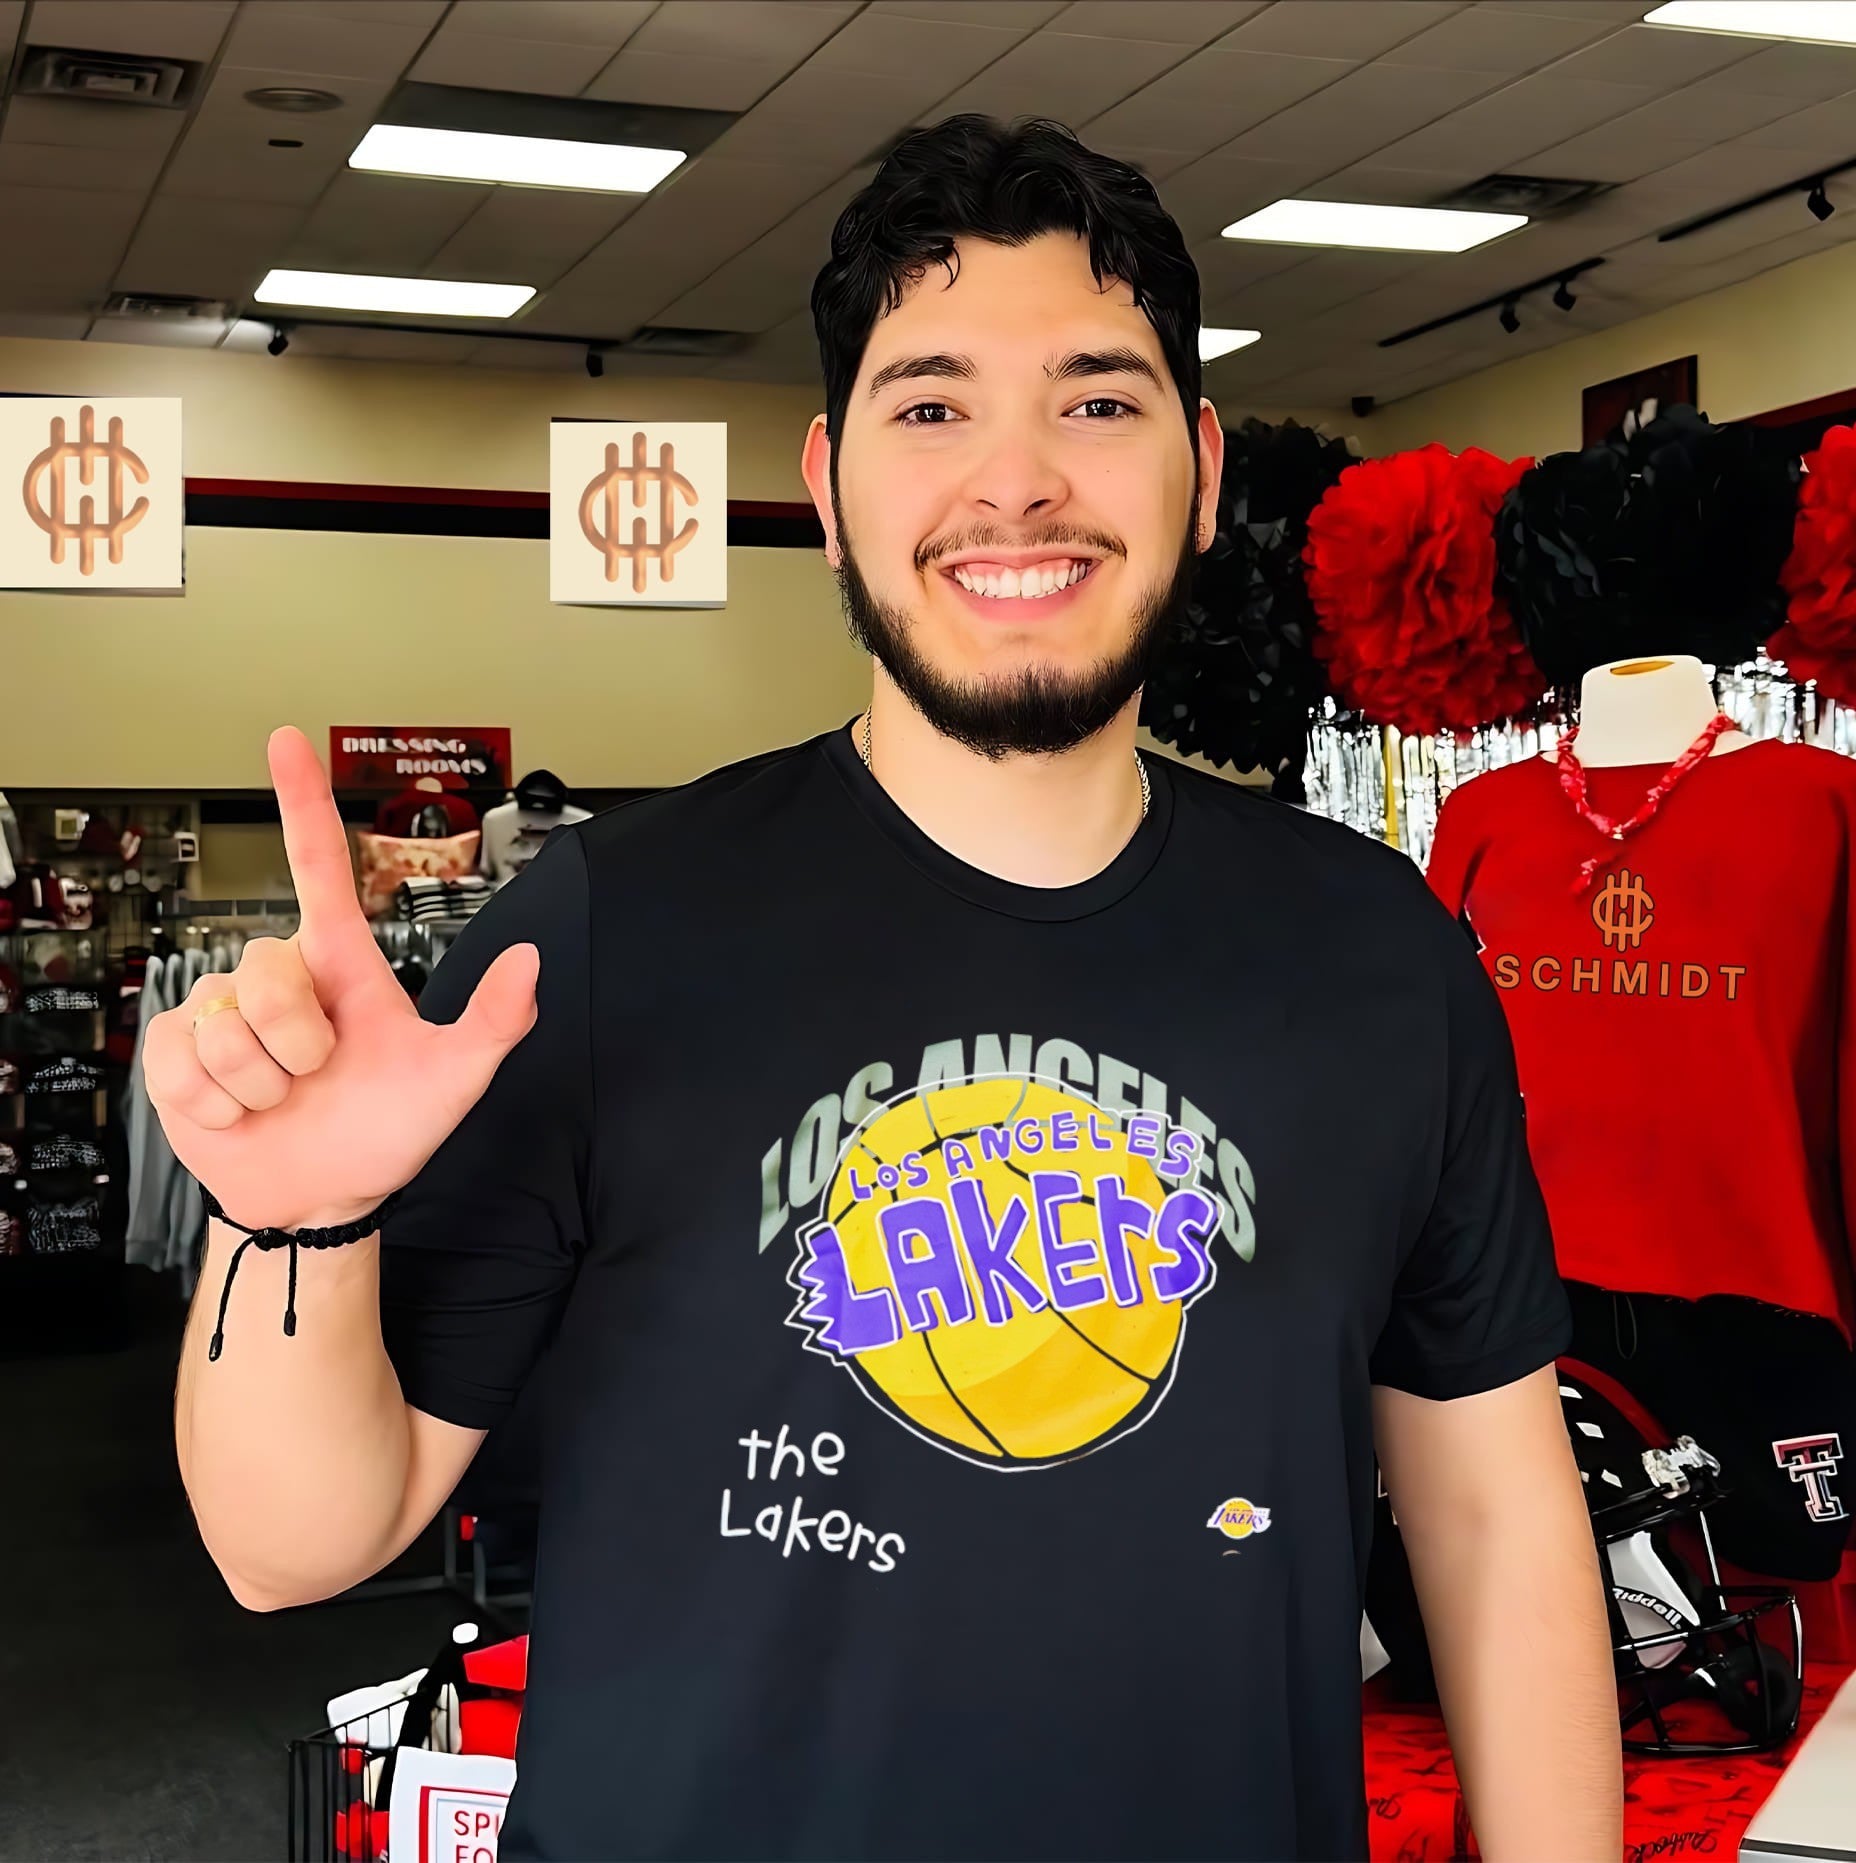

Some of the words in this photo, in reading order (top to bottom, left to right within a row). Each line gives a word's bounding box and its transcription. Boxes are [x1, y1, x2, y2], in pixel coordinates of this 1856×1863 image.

[342, 737, 467, 754] DRESSING
[396, 758, 487, 775] ROOMS
[1494, 953, 1747, 1000] SCHMIDT
[758, 1060, 894, 1255] LOS
[849, 1151, 930, 1202] LOS
[941, 1111, 1196, 1179] ANGELES
[738, 1425, 846, 1480] the
[719, 1488, 906, 1572] Lakers
